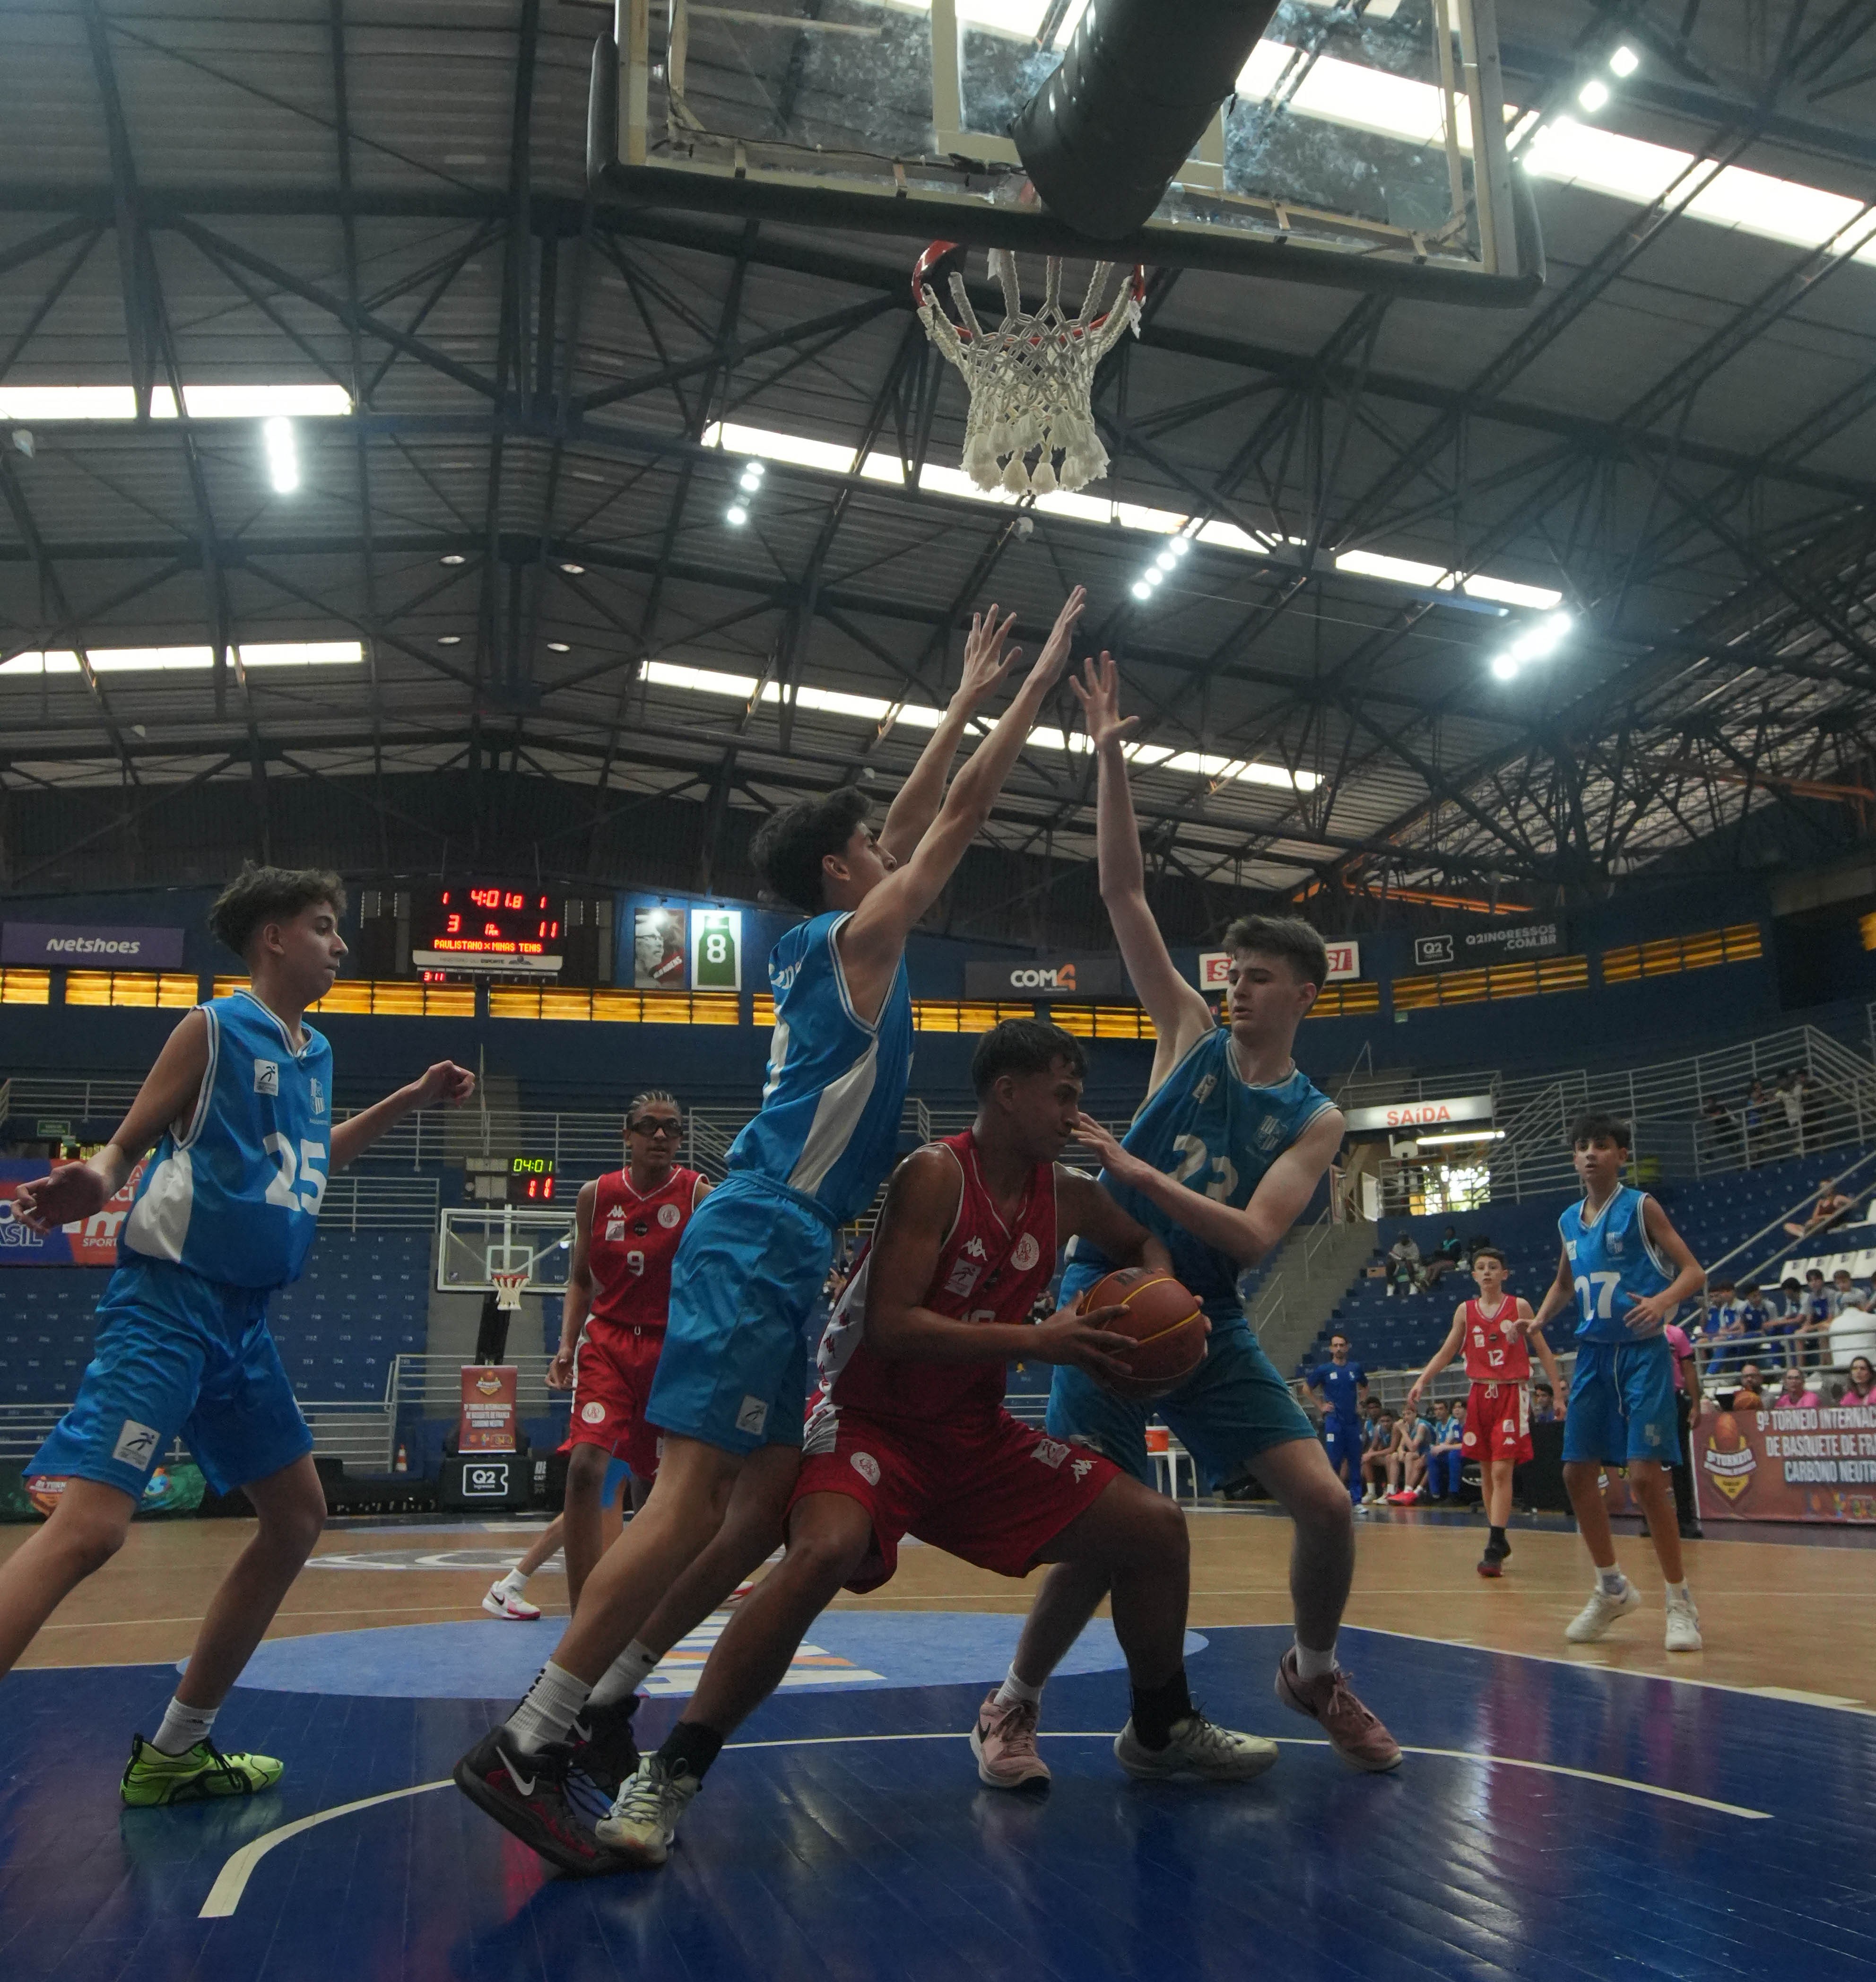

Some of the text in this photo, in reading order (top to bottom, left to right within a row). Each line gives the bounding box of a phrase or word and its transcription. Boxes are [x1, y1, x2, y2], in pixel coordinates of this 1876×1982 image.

[443, 892, 448, 904] 1
[540, 896, 546, 909] 1
[447, 914, 460, 932] 3
[539, 921, 557, 938] 11
[1466, 924, 1556, 945] Q2INGRESSOS
[434, 939, 482, 950] PAULISTANO
[492, 941, 515, 952] MINAS
[518, 943, 542, 953] TENIS
[707, 934, 726, 964] 8
[1424, 943, 1442, 954] Q2
[263, 1131, 327, 1216] 25
[513, 1158, 552, 1173] 04:01
[529, 1177, 552, 1198] 11
[627, 1250, 644, 1276] 9
[1487, 1349, 1504, 1366] 12
[1770, 1408, 1818, 1431] TORNEIO
[1765, 1435, 1781, 1457] DE
[1781, 1435, 1840, 1457] BASQUETE
[1840, 1434, 1858, 1456] DE
[472, 1469, 495, 1484] Q2
[1784, 1460, 1838, 1483] CARBONO
